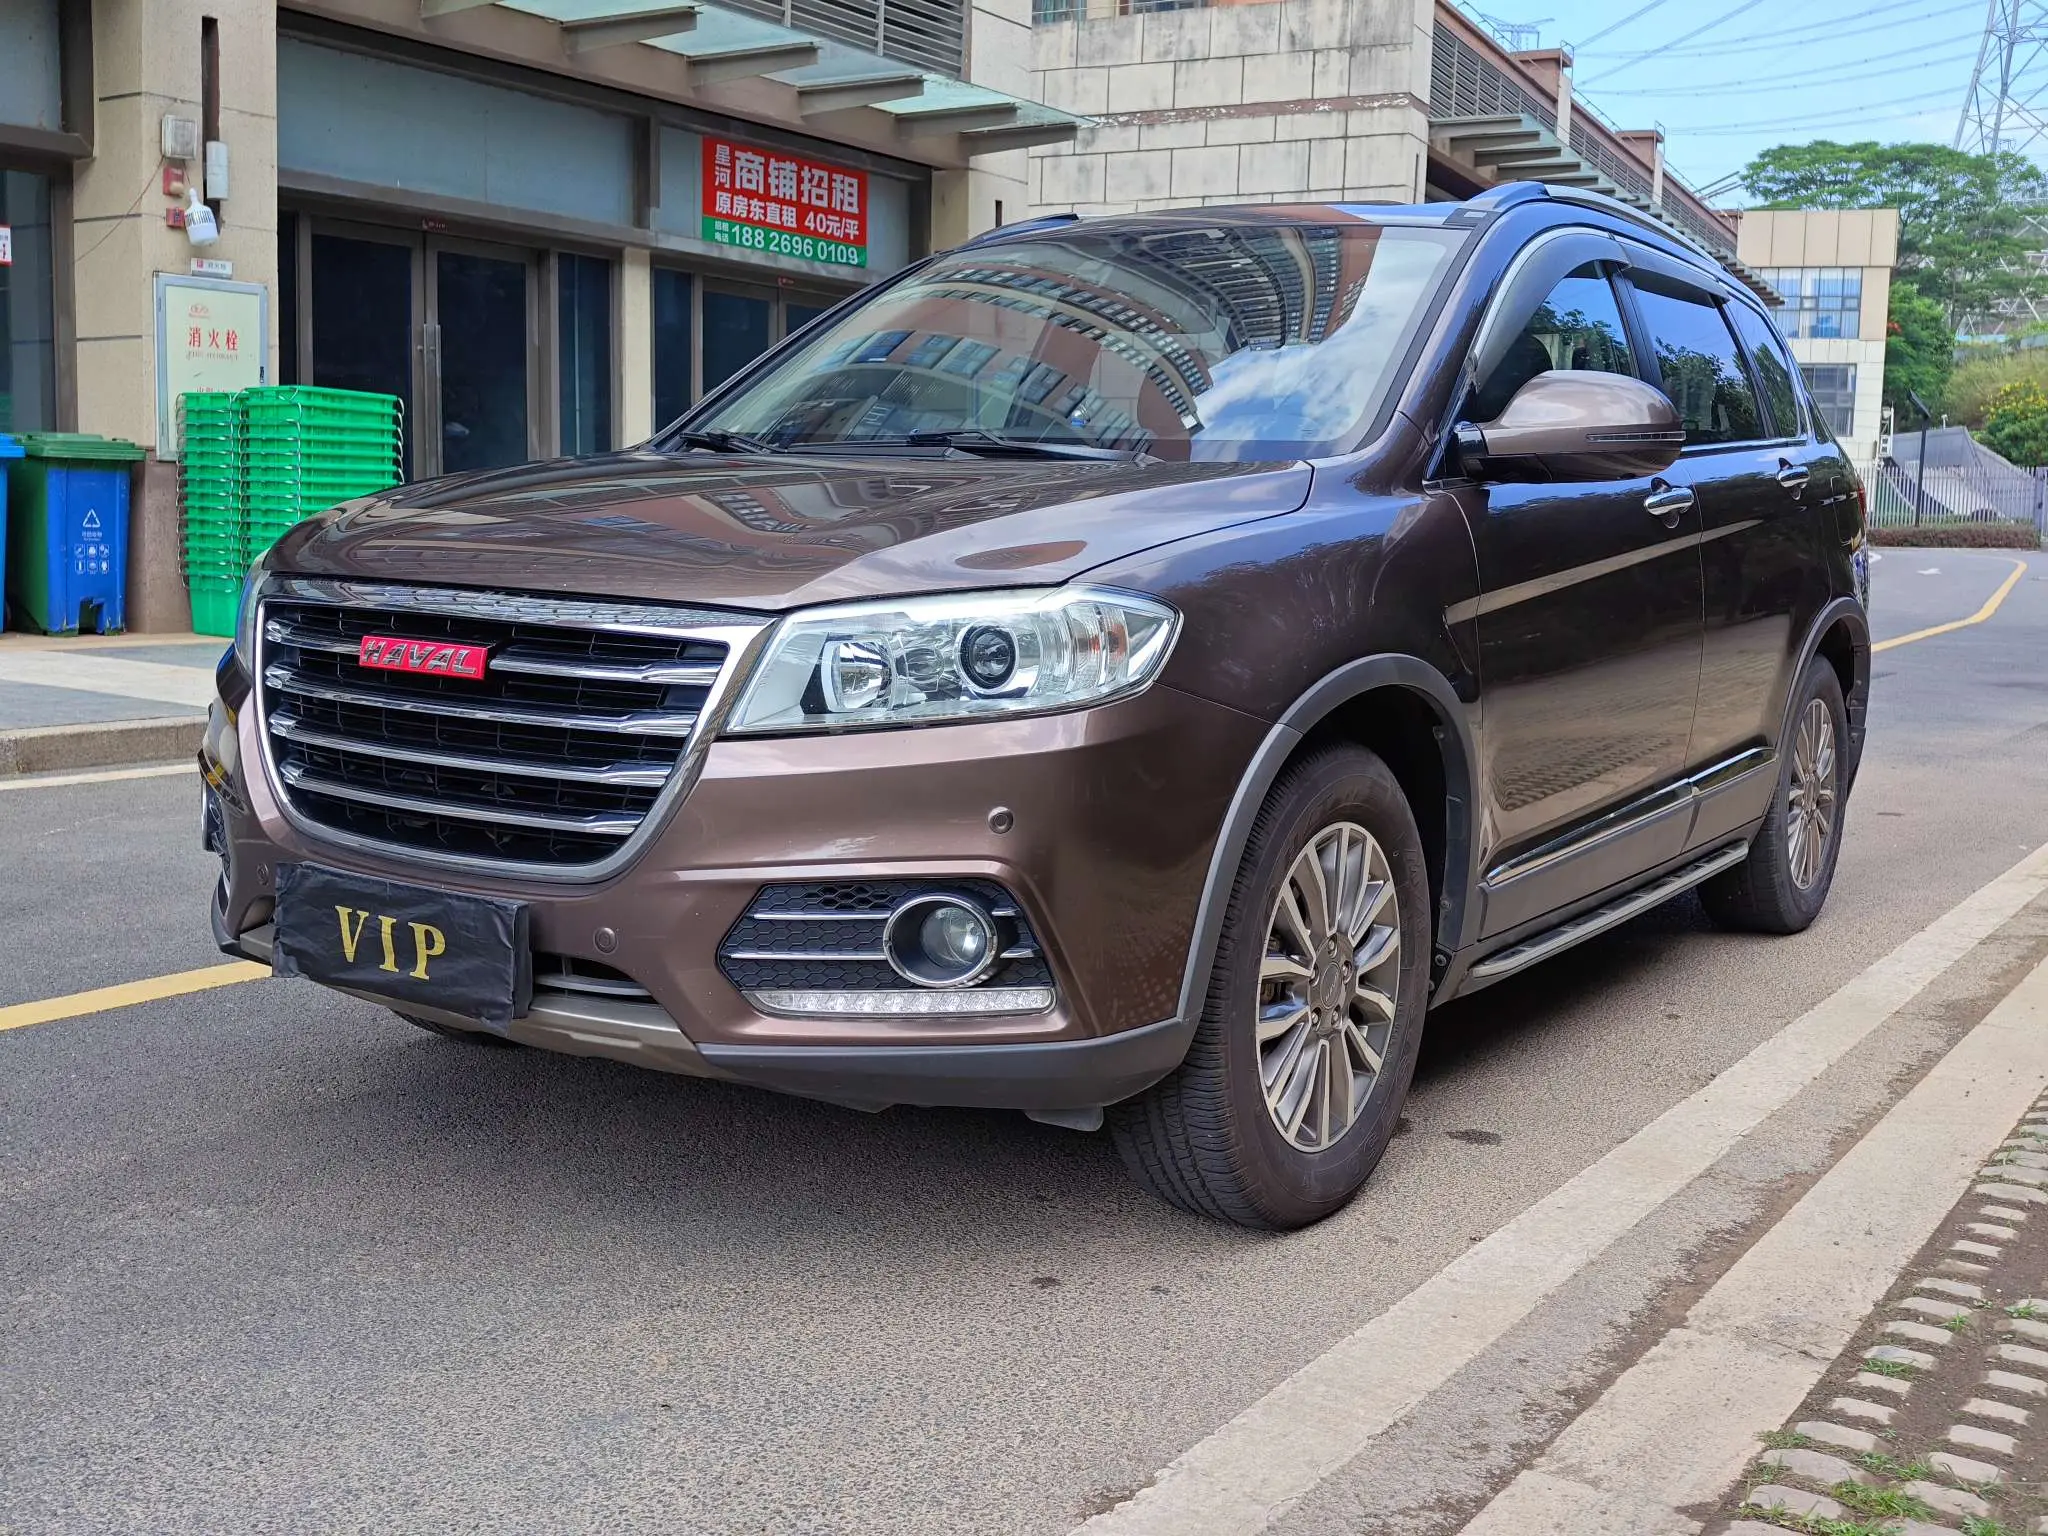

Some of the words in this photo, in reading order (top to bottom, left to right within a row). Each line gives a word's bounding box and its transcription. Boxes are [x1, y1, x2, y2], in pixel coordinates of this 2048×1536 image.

[715, 143, 731, 189] 星河
[734, 150, 860, 215] 商铺招租
[715, 191, 798, 228] 原房东直租
[804, 211, 860, 240] 40元/平
[731, 224, 765, 249] 188
[769, 231, 813, 257] 2696
[817, 243, 859, 265] 0109
[189, 327, 238, 351] 消火栓
[361, 639, 477, 675] HAVAL
[334, 905, 446, 981] VIP
